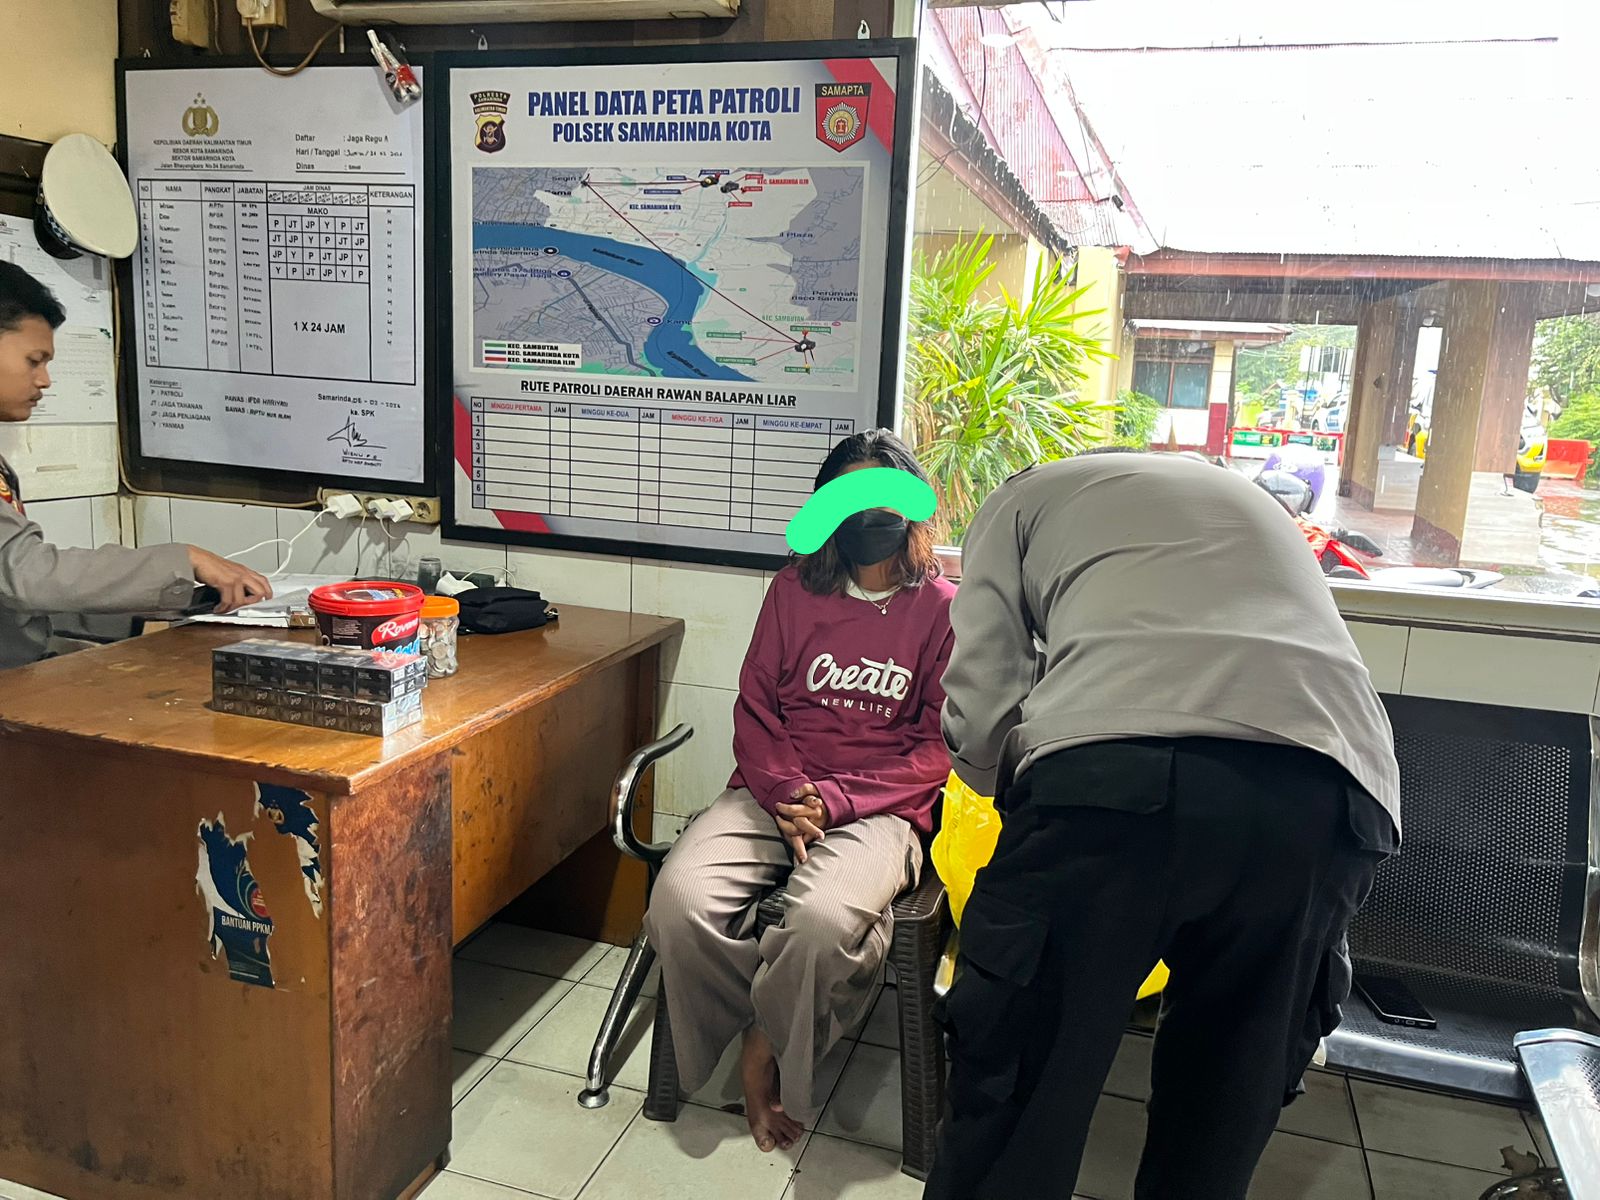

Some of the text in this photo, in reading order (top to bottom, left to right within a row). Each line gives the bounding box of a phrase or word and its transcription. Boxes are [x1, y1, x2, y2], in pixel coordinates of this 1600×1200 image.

[821, 85, 864, 96] SAMAPTA
[528, 87, 800, 117] PANEL DATA PETA PATROLI
[553, 120, 772, 142] POLSEK SAMARINDA KOTA
[347, 135, 363, 143] Jaga
[365, 135, 383, 144] Regu
[314, 148, 340, 157] Tanggal
[355, 222, 364, 230] JT
[289, 235, 298, 243] JP
[322, 252, 332, 260] JT
[294, 322, 345, 334] 1 X 24 JAM
[521, 380, 797, 407] RUTE PATROLI DAERAH RAWAN BALAPAN LIAR
[515, 404, 542, 412] PERTAMA
[581, 408, 630, 418] MINGGU KE-DUA
[177, 413, 211, 421] PENJAGAAN
[672, 414, 724, 424] MINGGU KE-TIGA
[762, 419, 822, 430] MINGGU KE-EMPAT
[806, 653, 913, 701] Create
[821, 698, 892, 718] NEW LIFE
[221, 915, 251, 931] BANTUAN
